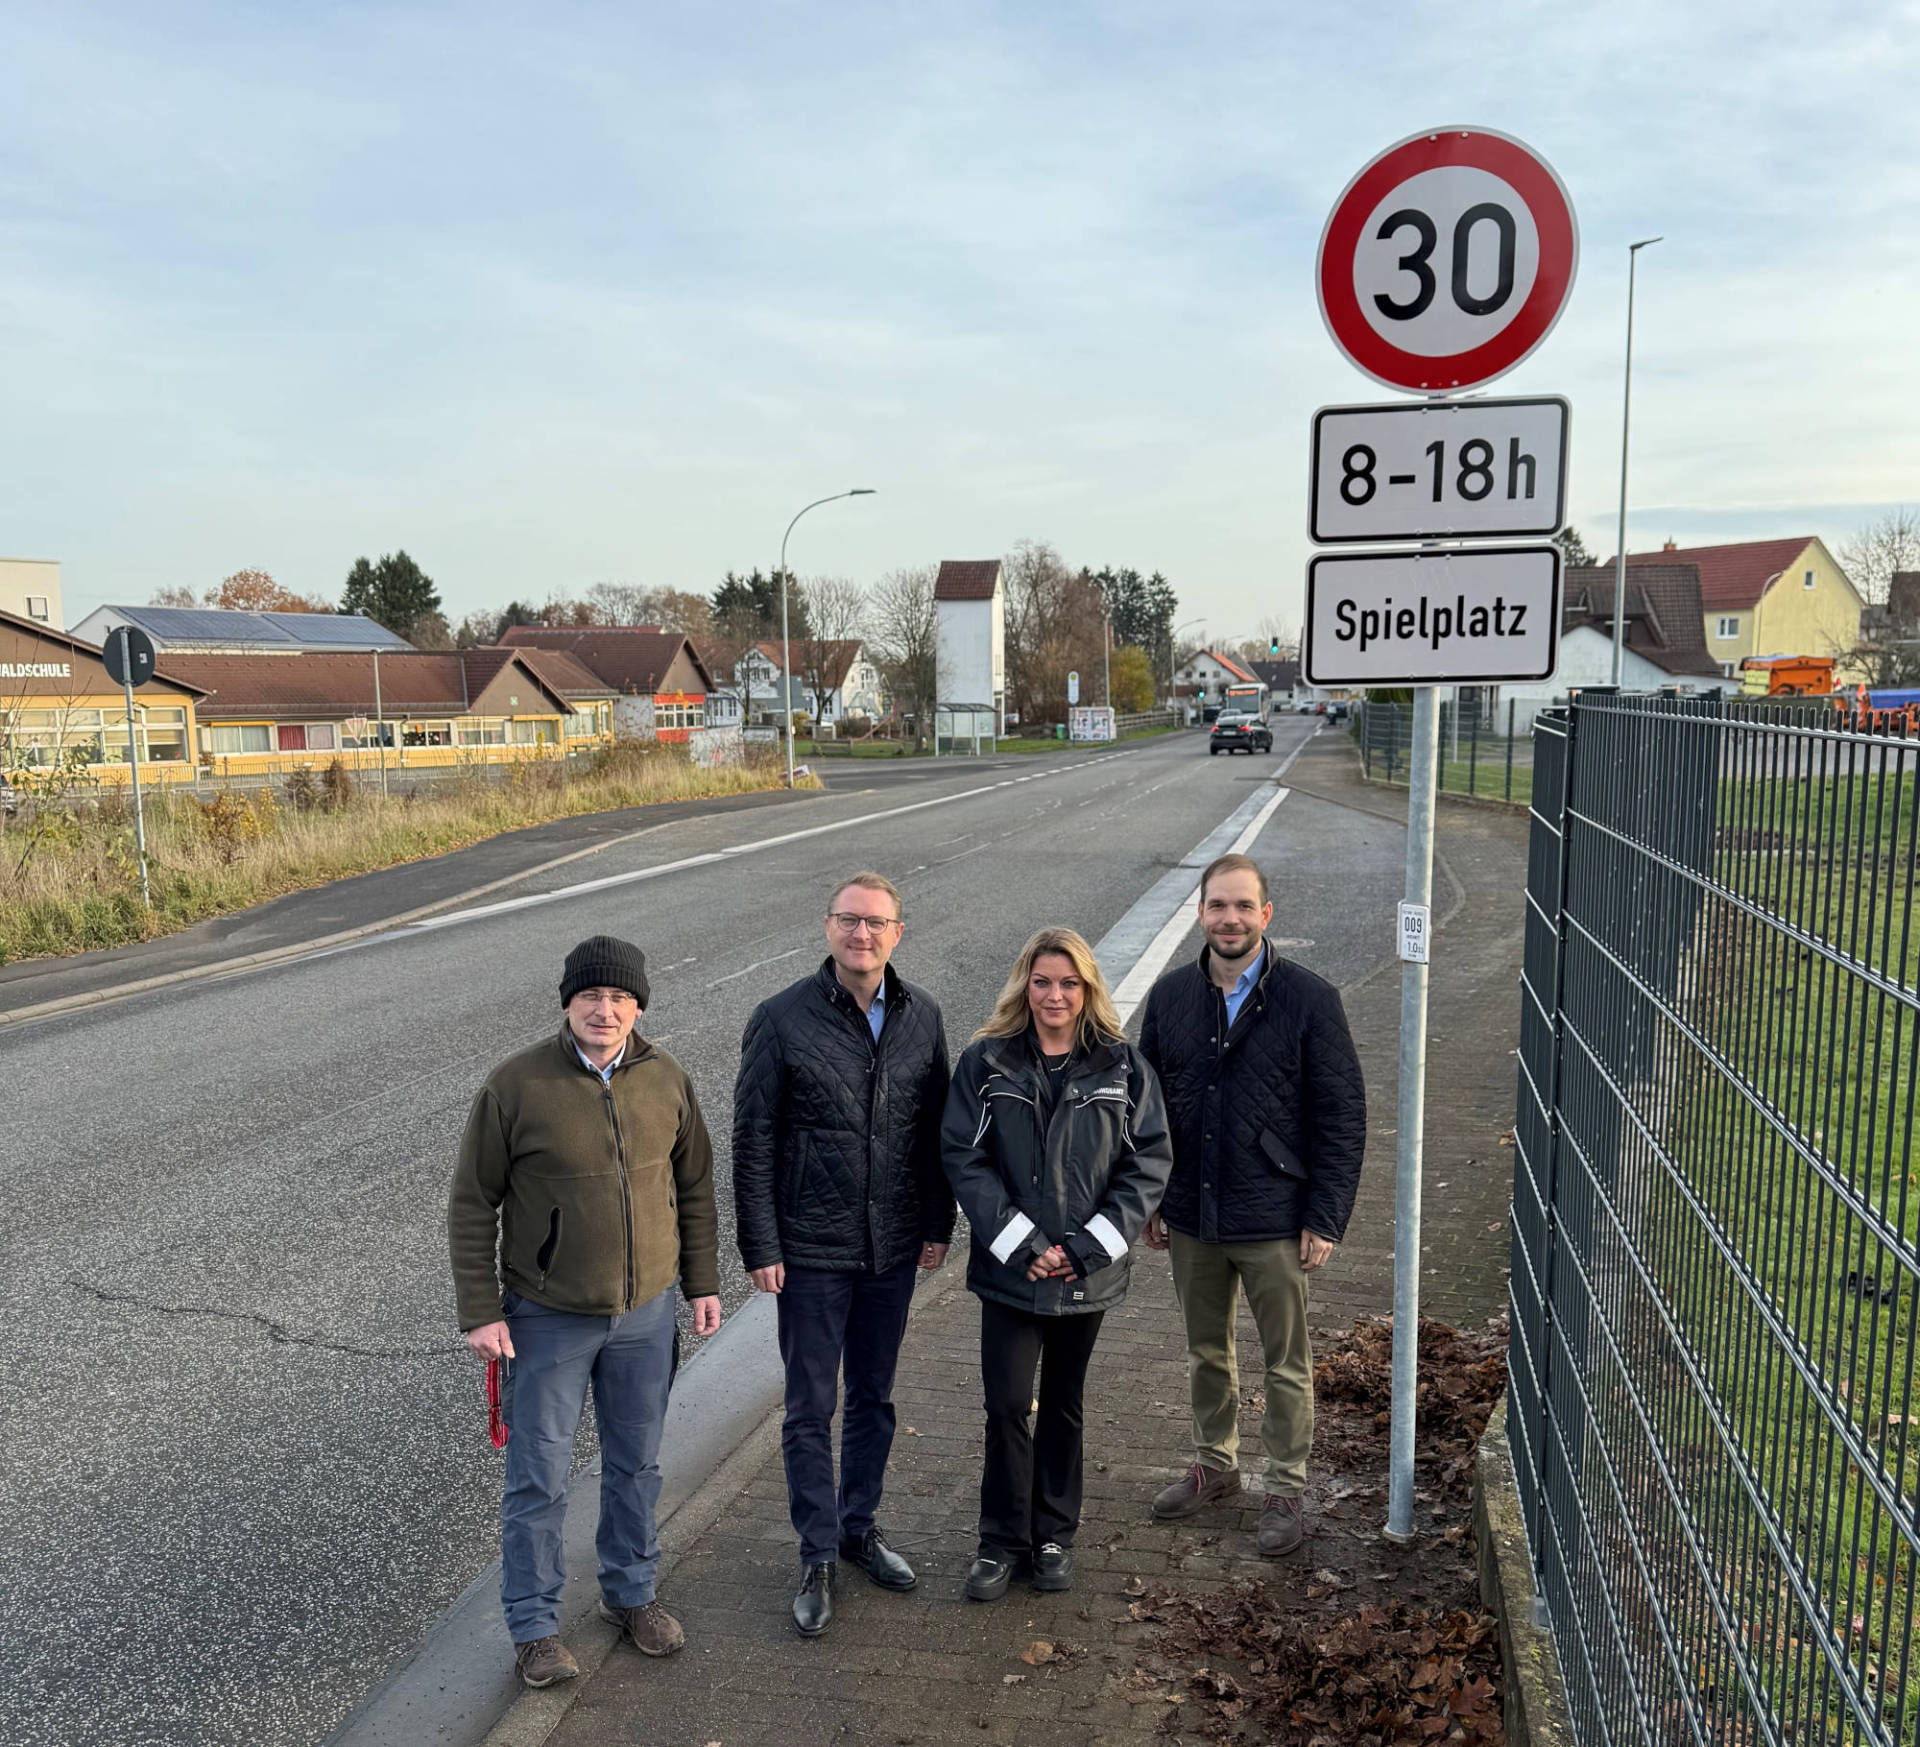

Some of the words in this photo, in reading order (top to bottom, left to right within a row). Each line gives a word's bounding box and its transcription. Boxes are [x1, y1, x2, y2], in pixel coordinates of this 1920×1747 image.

[1373, 202, 1516, 321] 30
[1335, 595, 1527, 652] Spielplatz
[0, 663, 71, 678] ALDSCHULE
[1404, 916, 1422, 933] 009
